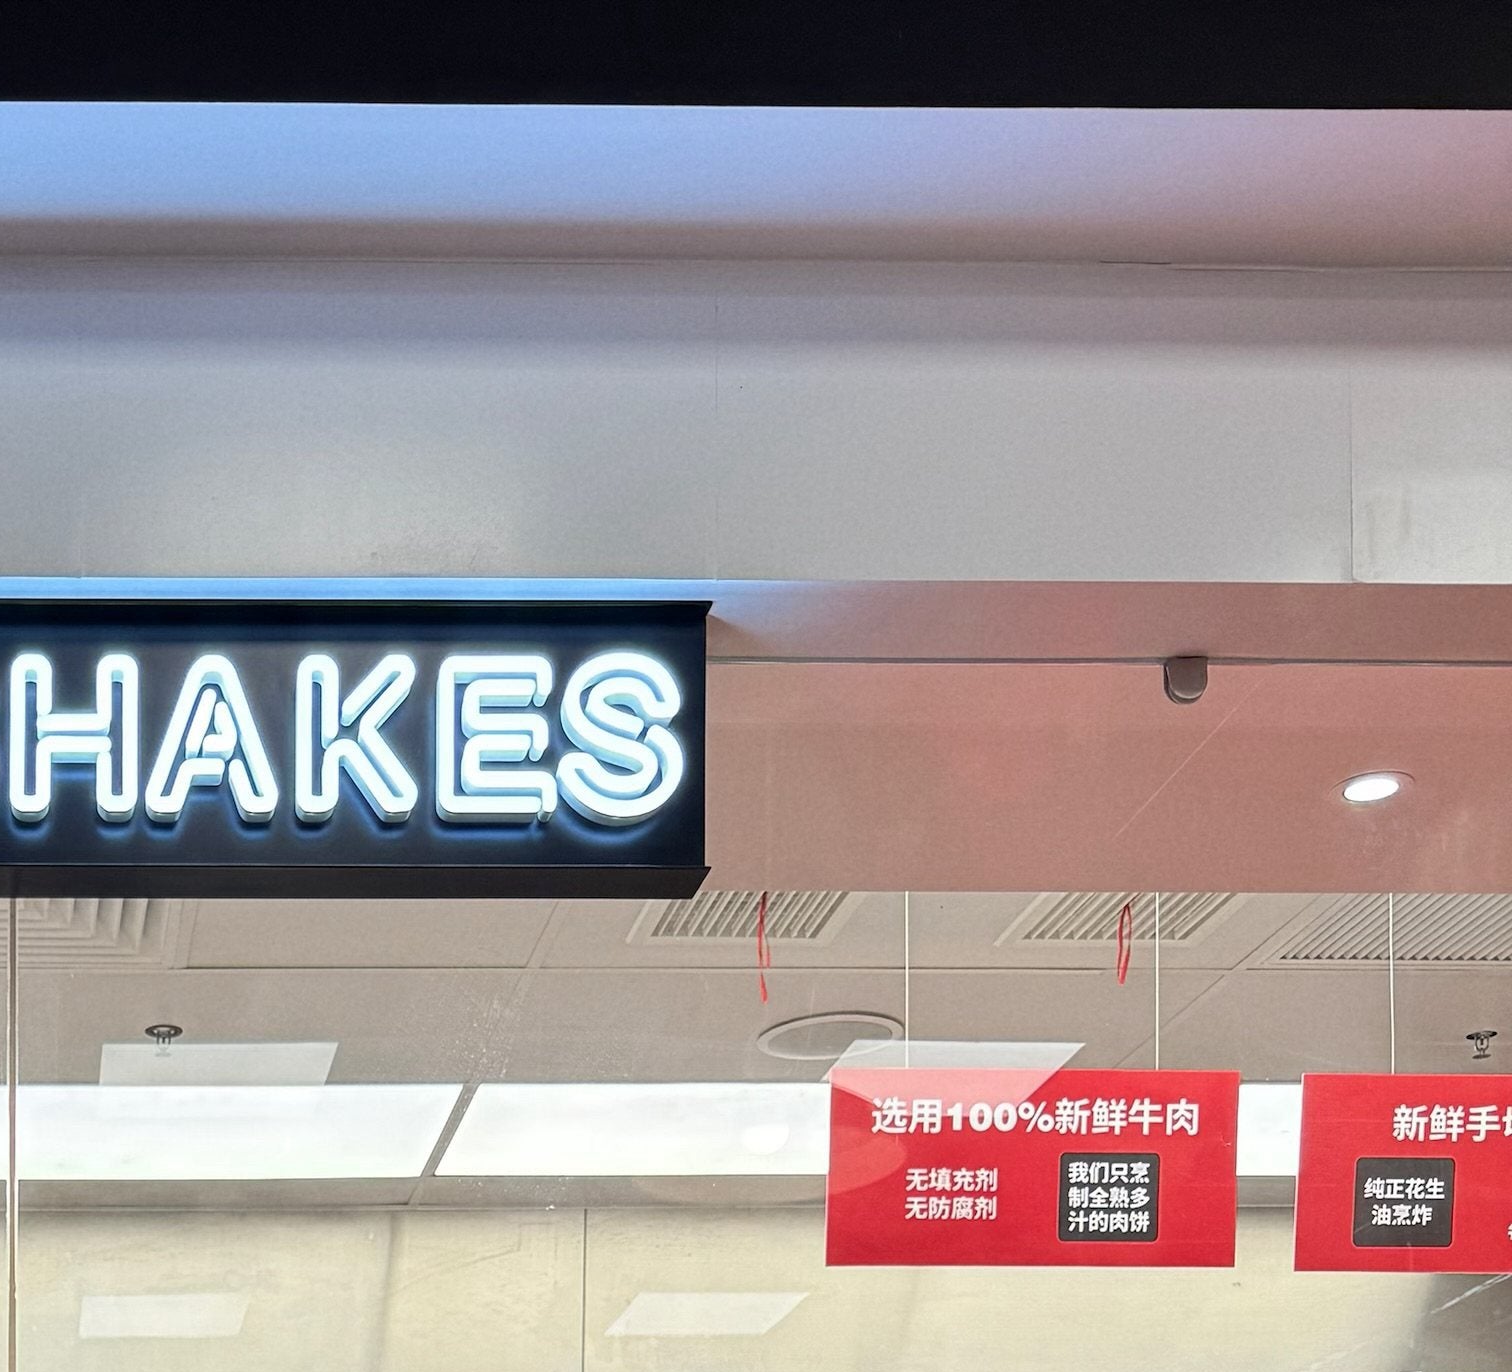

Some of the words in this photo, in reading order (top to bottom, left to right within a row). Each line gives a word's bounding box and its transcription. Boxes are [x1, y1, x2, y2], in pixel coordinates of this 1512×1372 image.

[871, 1097, 1200, 1136] 选用100%新鲜牛肉
[905, 1167, 999, 1193] 无填充剂
[1068, 1162, 1151, 1185] 我们只烹
[1068, 1187, 1151, 1209] 制全熟多
[1363, 1177, 1445, 1200] 纯正花生
[904, 1196, 998, 1221] 无防腐剂
[1371, 1204, 1433, 1226] 油烹炸
[1068, 1211, 1151, 1234] 汁的肉饼
